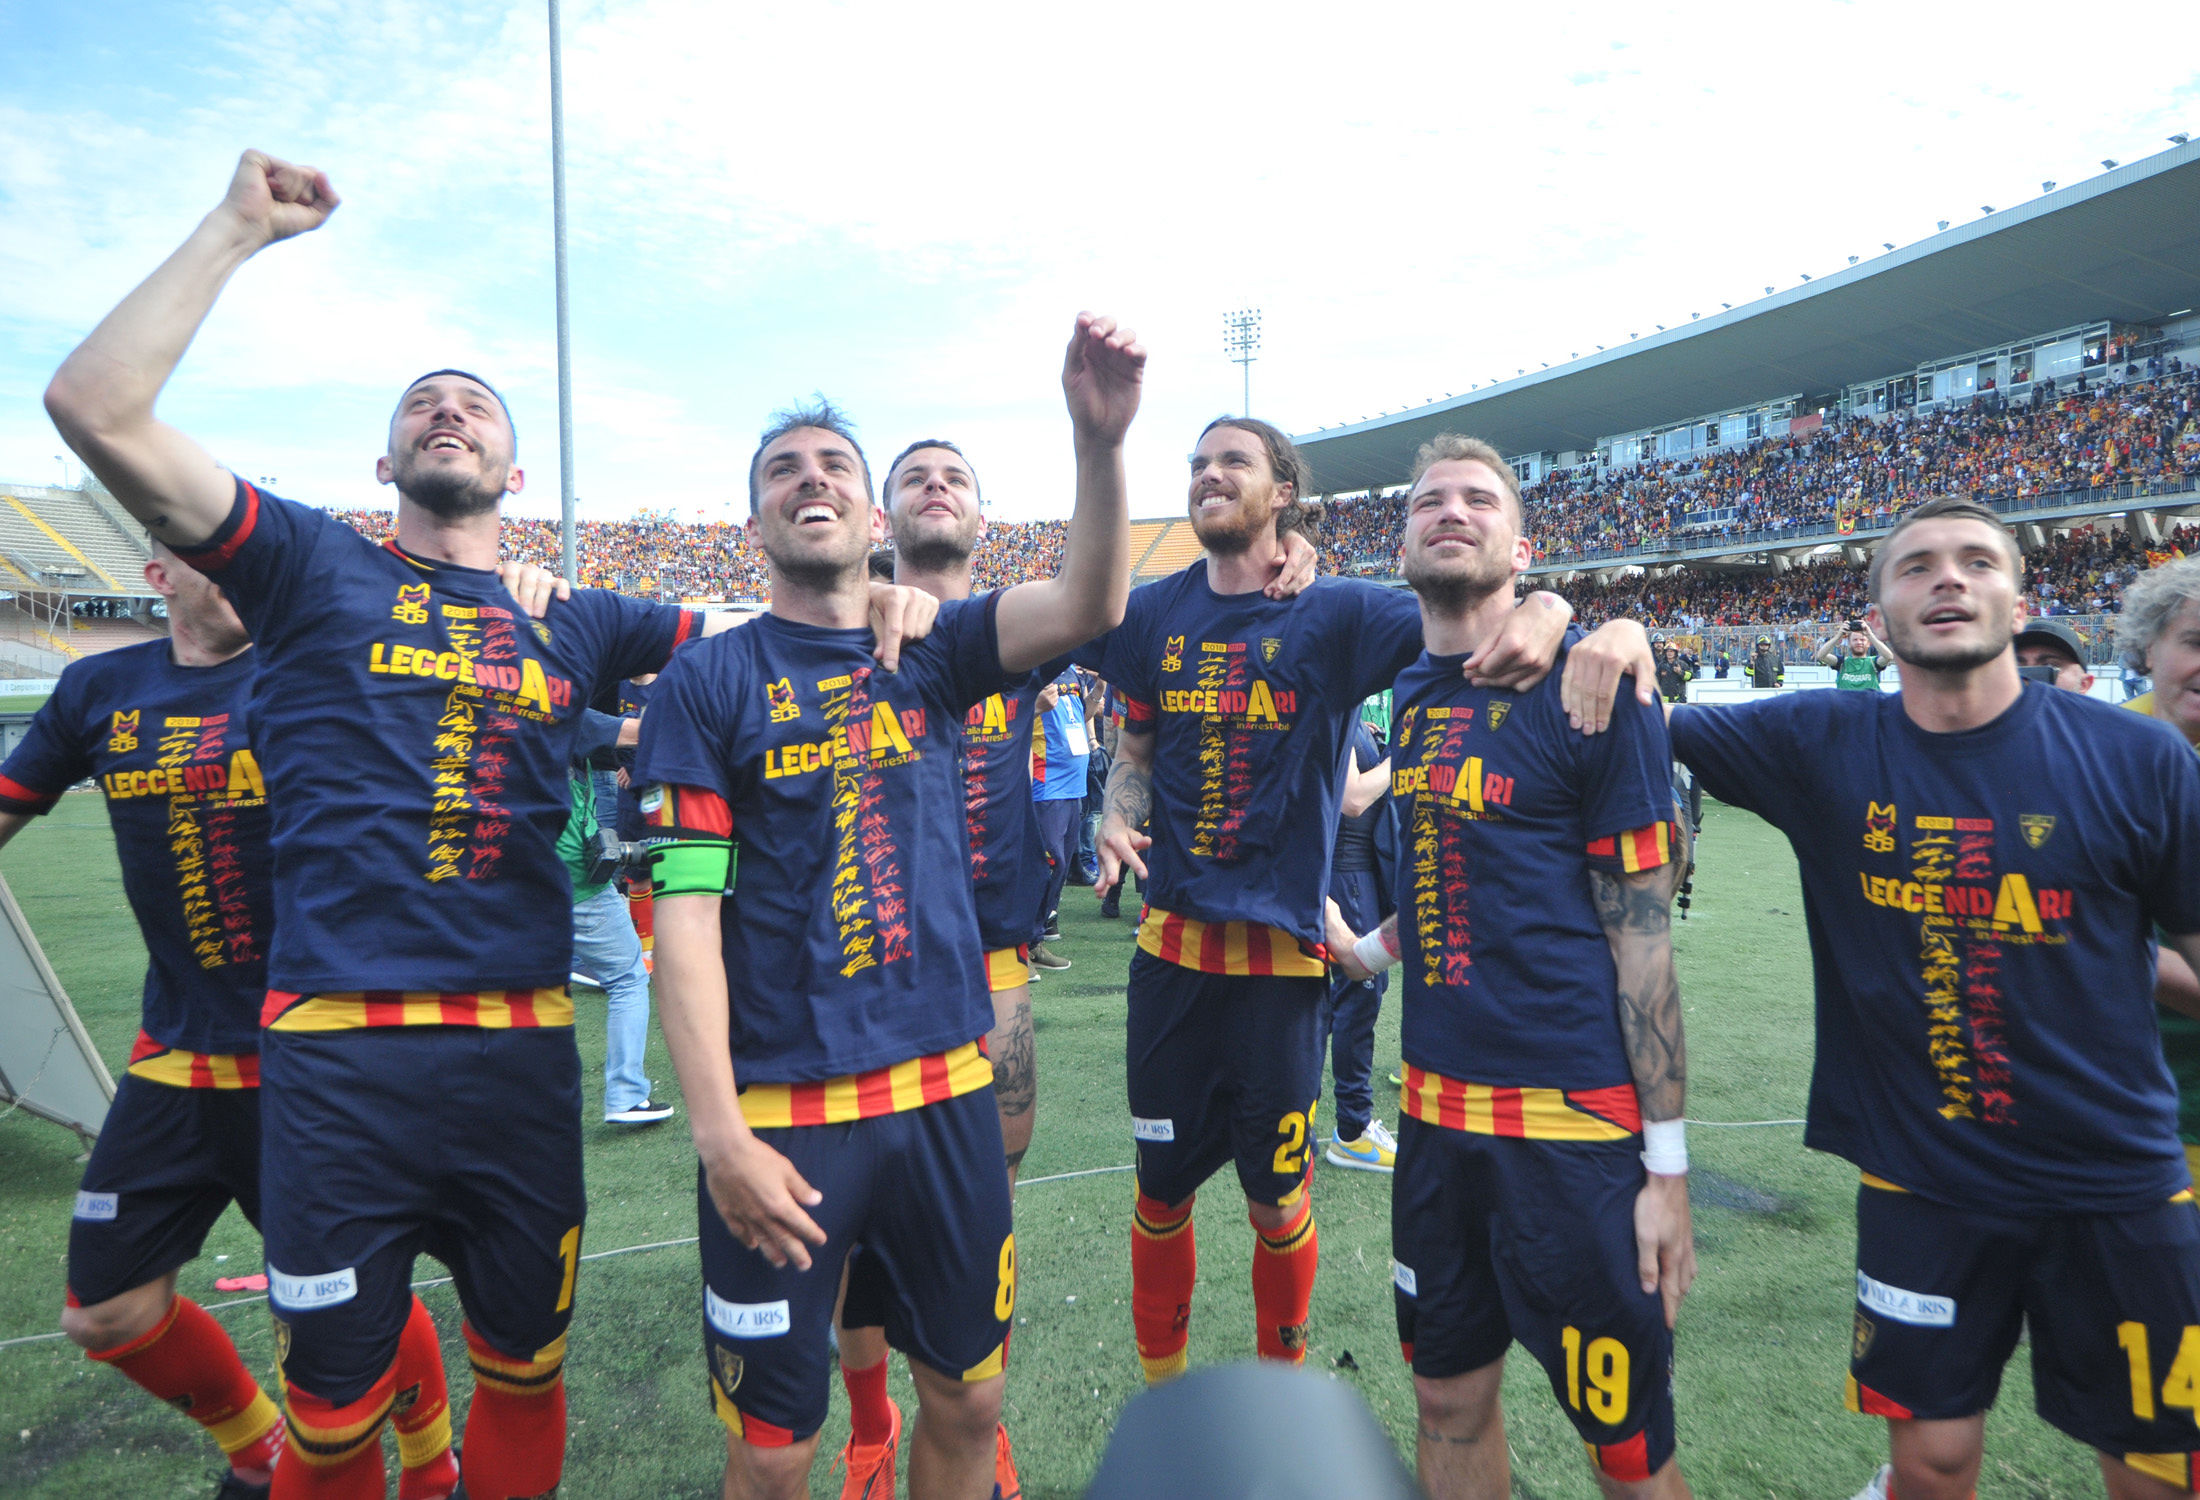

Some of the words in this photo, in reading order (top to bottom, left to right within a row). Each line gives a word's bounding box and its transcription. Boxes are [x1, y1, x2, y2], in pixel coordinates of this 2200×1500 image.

[822, 677, 850, 690] 2018
[314, 1276, 350, 1298] IRIS
[994, 1232, 1017, 1323] 8
[754, 1308, 784, 1326] IRIS
[1917, 1298, 1948, 1314] IRIS
[1562, 1324, 1630, 1425] 19
[2117, 1320, 2200, 1432] 14
